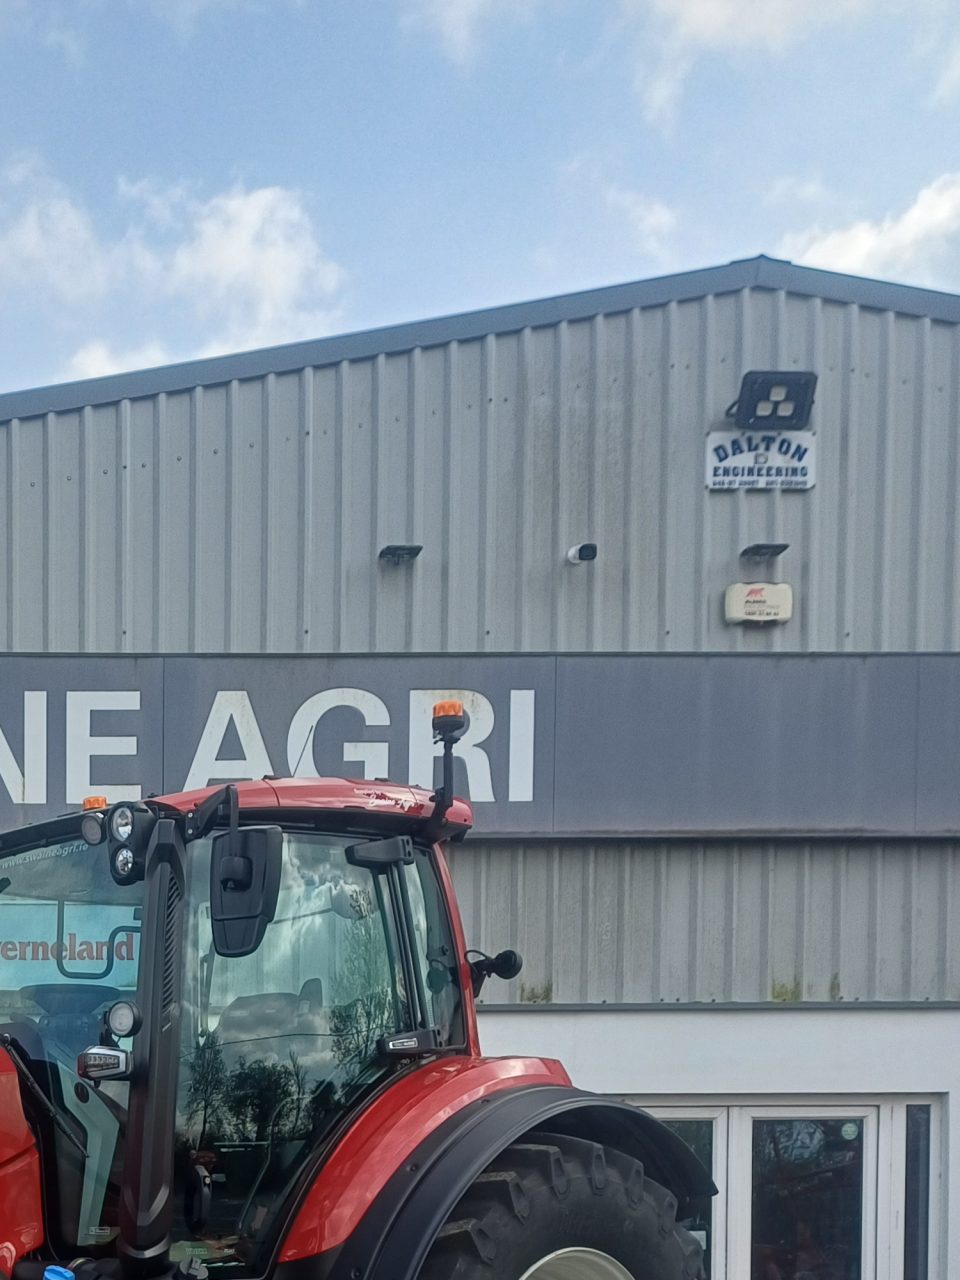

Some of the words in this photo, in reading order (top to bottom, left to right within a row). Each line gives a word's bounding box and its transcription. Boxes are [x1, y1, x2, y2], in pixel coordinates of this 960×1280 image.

[713, 435, 808, 463] DALTON
[712, 466, 808, 477] ENGINEERING
[182, 687, 536, 803] AGRI
